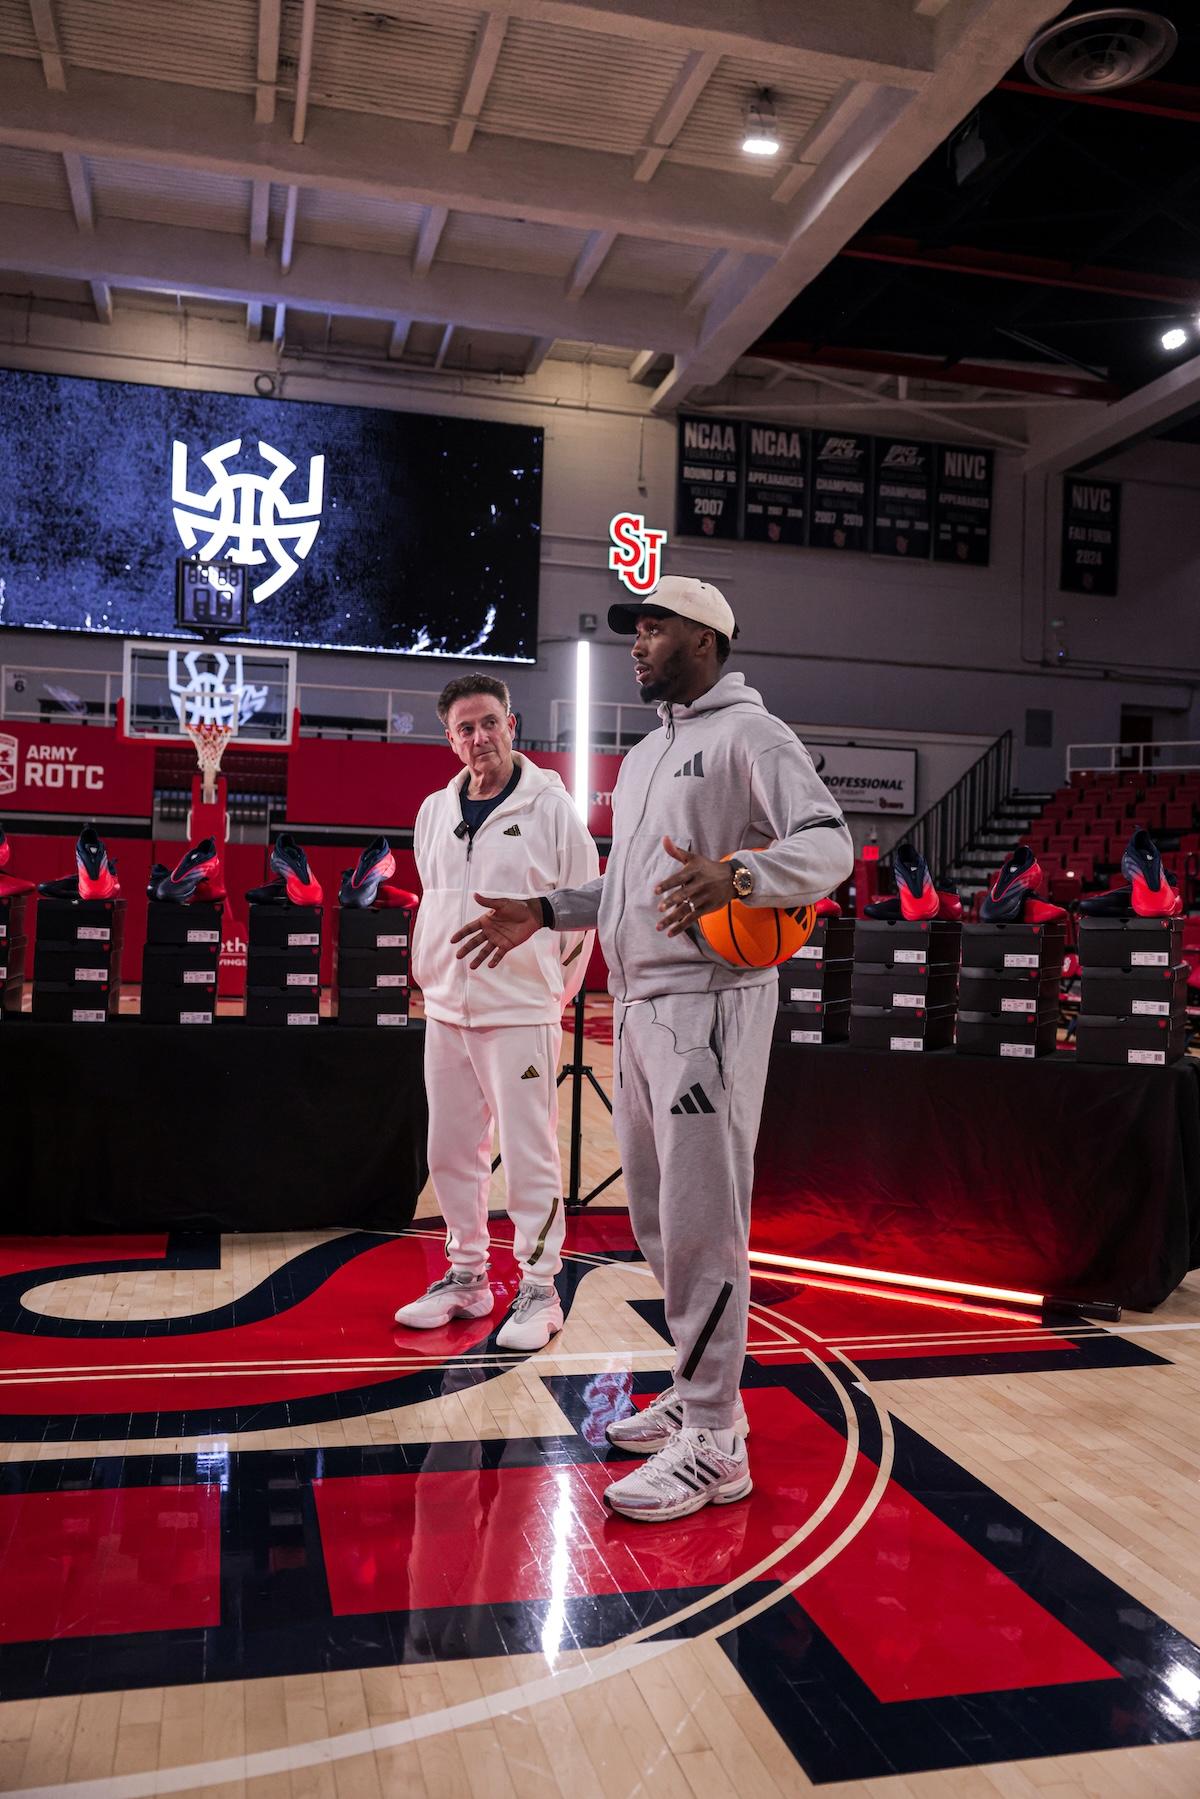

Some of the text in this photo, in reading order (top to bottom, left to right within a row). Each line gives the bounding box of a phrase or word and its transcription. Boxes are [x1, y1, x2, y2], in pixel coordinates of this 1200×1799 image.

[684, 422, 737, 453] NCAA
[751, 428, 802, 459] NCAA
[827, 437, 857, 449] BIG
[819, 446, 865, 459] EAST
[890, 444, 920, 456] BIG
[882, 453, 926, 467] EAST
[944, 452, 987, 480] NIVC
[683, 466, 713, 481] ROUND
[714, 469, 725, 482] OF
[748, 471, 804, 489] APPEARANCES
[816, 478, 864, 494] CHAMPIONS
[879, 485, 927, 501] CHAMPIONS
[1072, 485, 1112, 512] NIVC
[694, 498, 724, 516] 2007
[14, 680, 25, 693] 6
[26, 745, 78, 761] ARMY
[24, 762, 104, 790] ROTC
